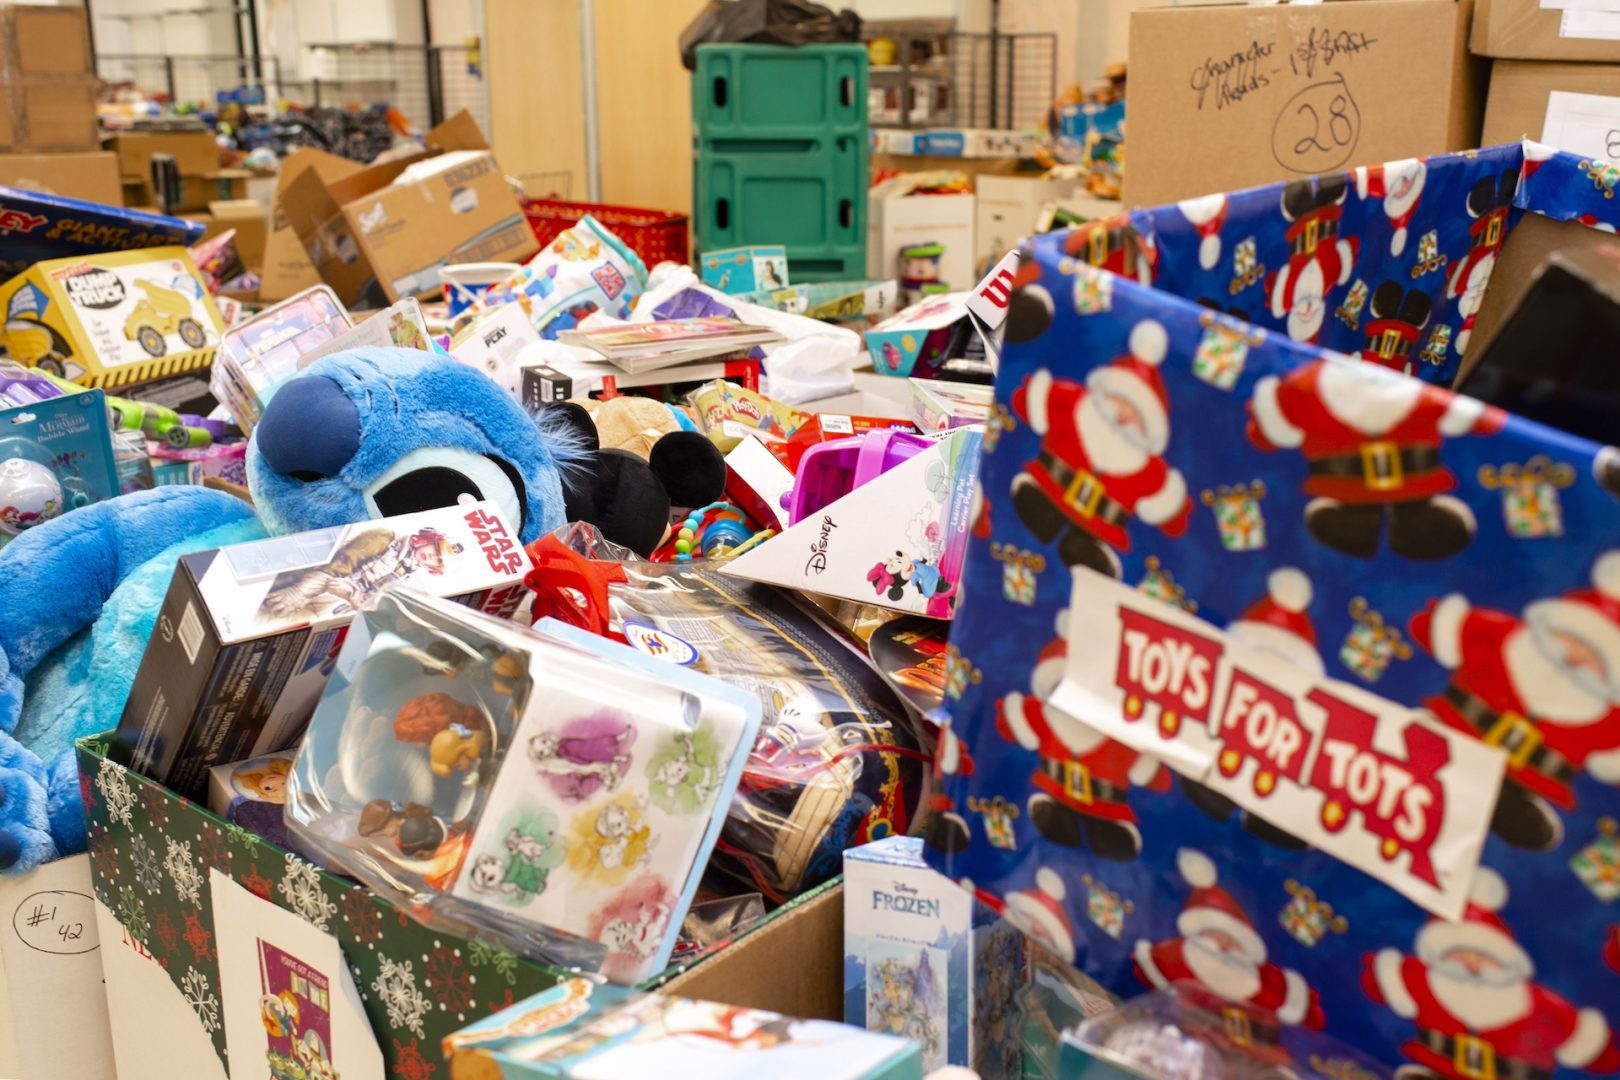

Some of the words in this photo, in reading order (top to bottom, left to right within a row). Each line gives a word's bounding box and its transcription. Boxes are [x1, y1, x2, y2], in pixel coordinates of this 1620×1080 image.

[1294, 94, 1352, 154] 28
[55, 218, 129, 241] GIANT
[69, 272, 118, 292] DUMP
[70, 285, 126, 307] TRUCK
[485, 326, 508, 348] PLAY
[957, 477, 966, 494] Pet
[967, 474, 977, 487] Set
[963, 487, 974, 506] Play
[950, 494, 966, 527] Learning
[957, 505, 970, 533] Carrier
[464, 510, 511, 575] WARS
[477, 509, 523, 575] STAR
[1124, 629, 1211, 710] TOYS
[1223, 680, 1302, 770] FOR
[1323, 738, 1434, 842] TOTS
[892, 880, 919, 895] Disney
[26, 904, 57, 927] #1
[872, 890, 940, 918] FROZEN
[58, 923, 83, 942] 42
